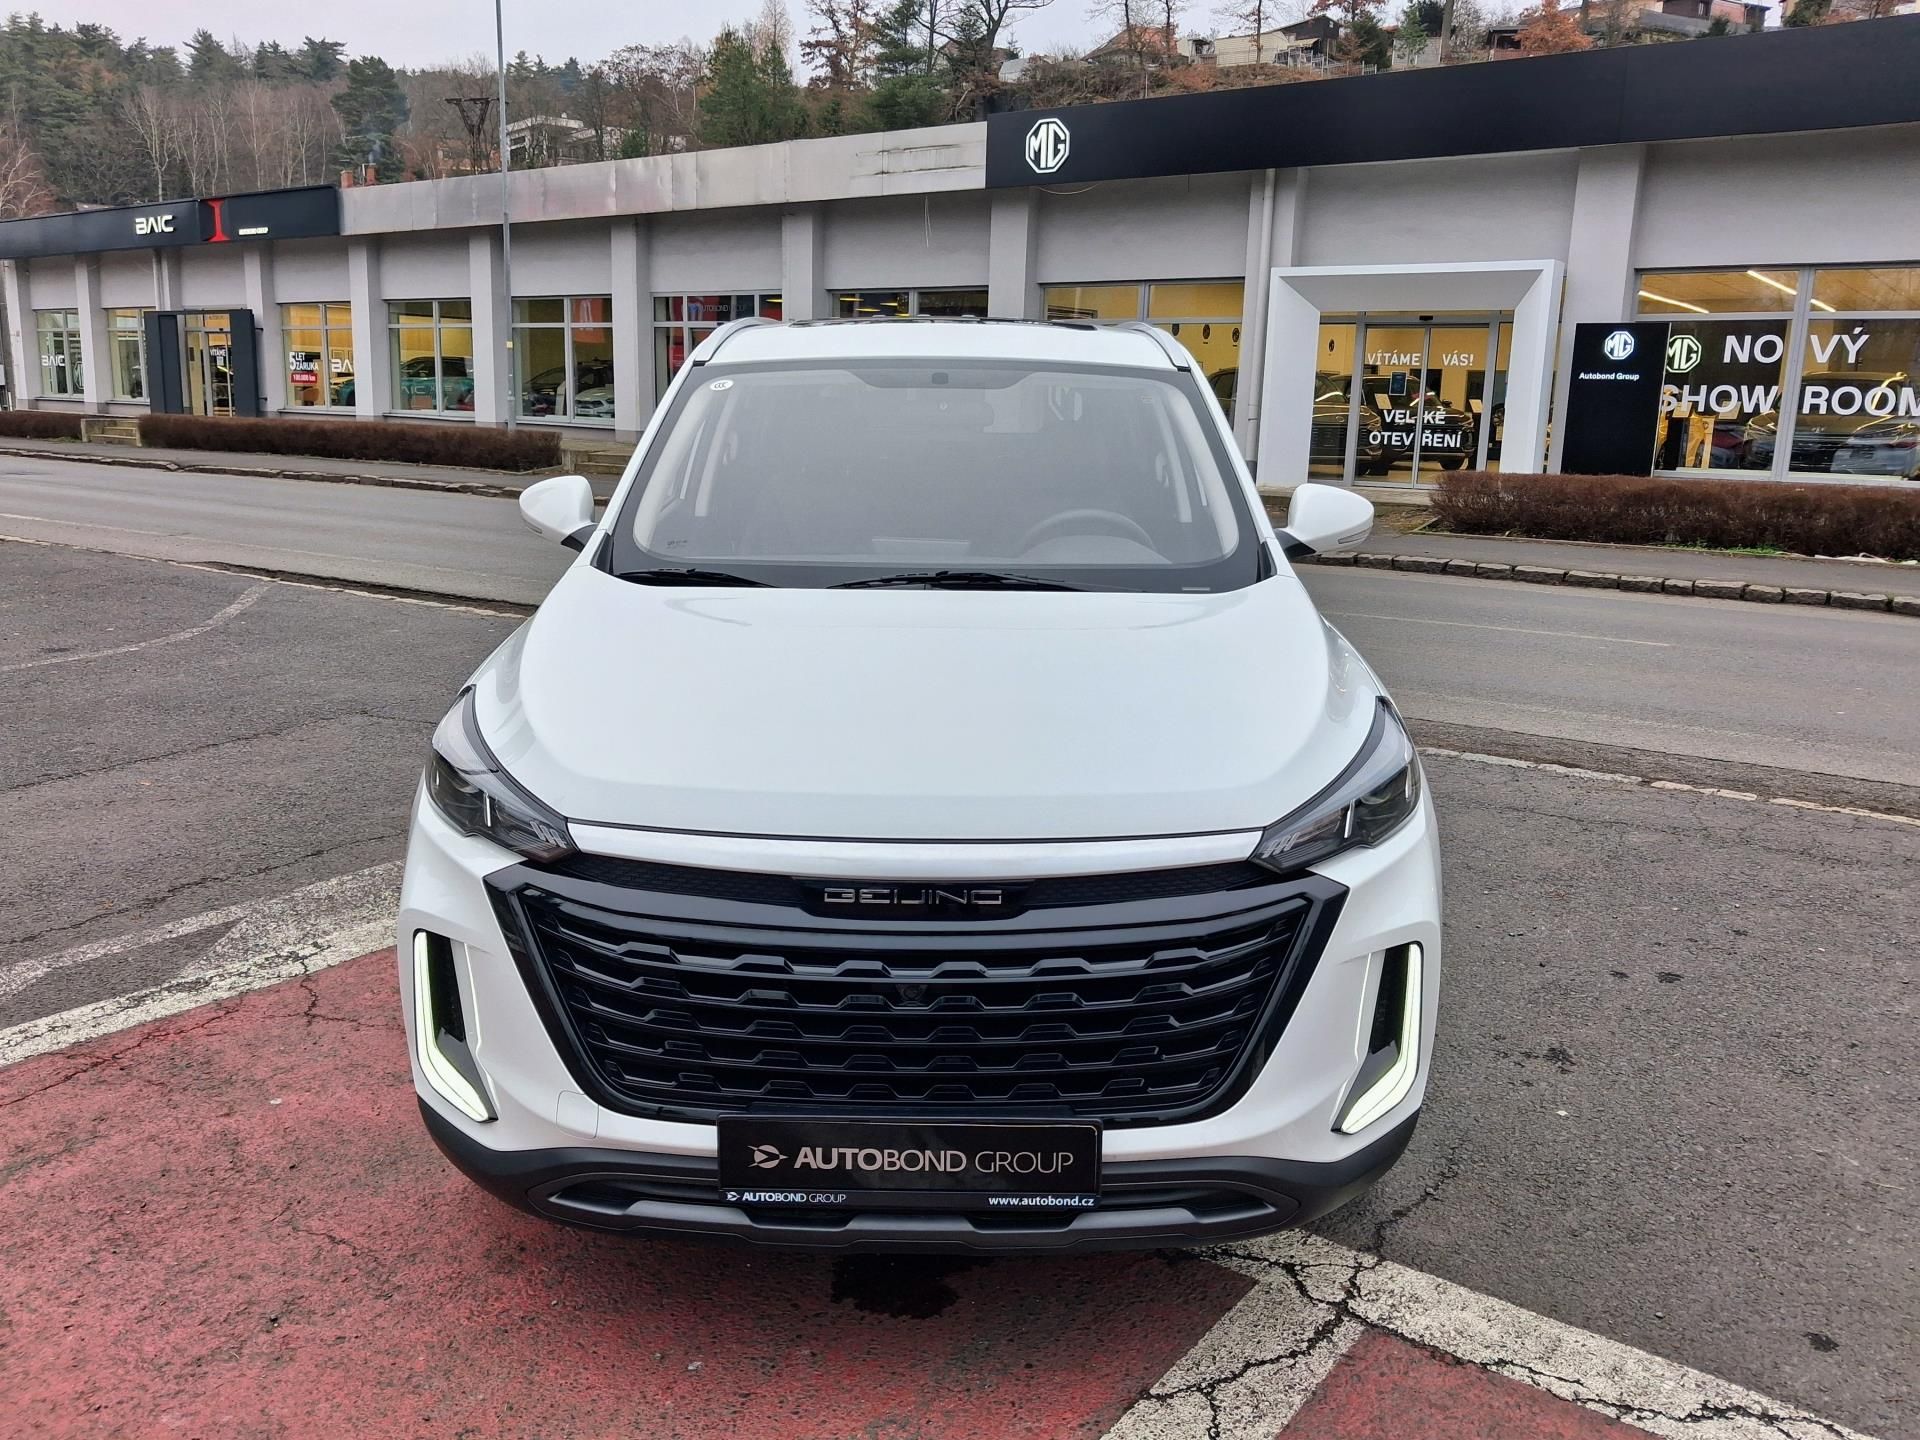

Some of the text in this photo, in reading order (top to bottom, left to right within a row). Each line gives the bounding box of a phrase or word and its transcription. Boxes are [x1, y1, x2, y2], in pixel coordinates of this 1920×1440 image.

[1028, 121, 1067, 170] MG
[135, 214, 174, 235] BAIC
[1605, 332, 1633, 359] MG
[1367, 349, 1474, 366] VÍTÁME VÁS!
[824, 887, 1002, 904] BEIJING
[794, 1146, 1074, 1173] AUTOBOND GROUP
[742, 1191, 847, 1203] AUTOBOND GROUP
[988, 1195, 1095, 1206] www.autobond.cz
